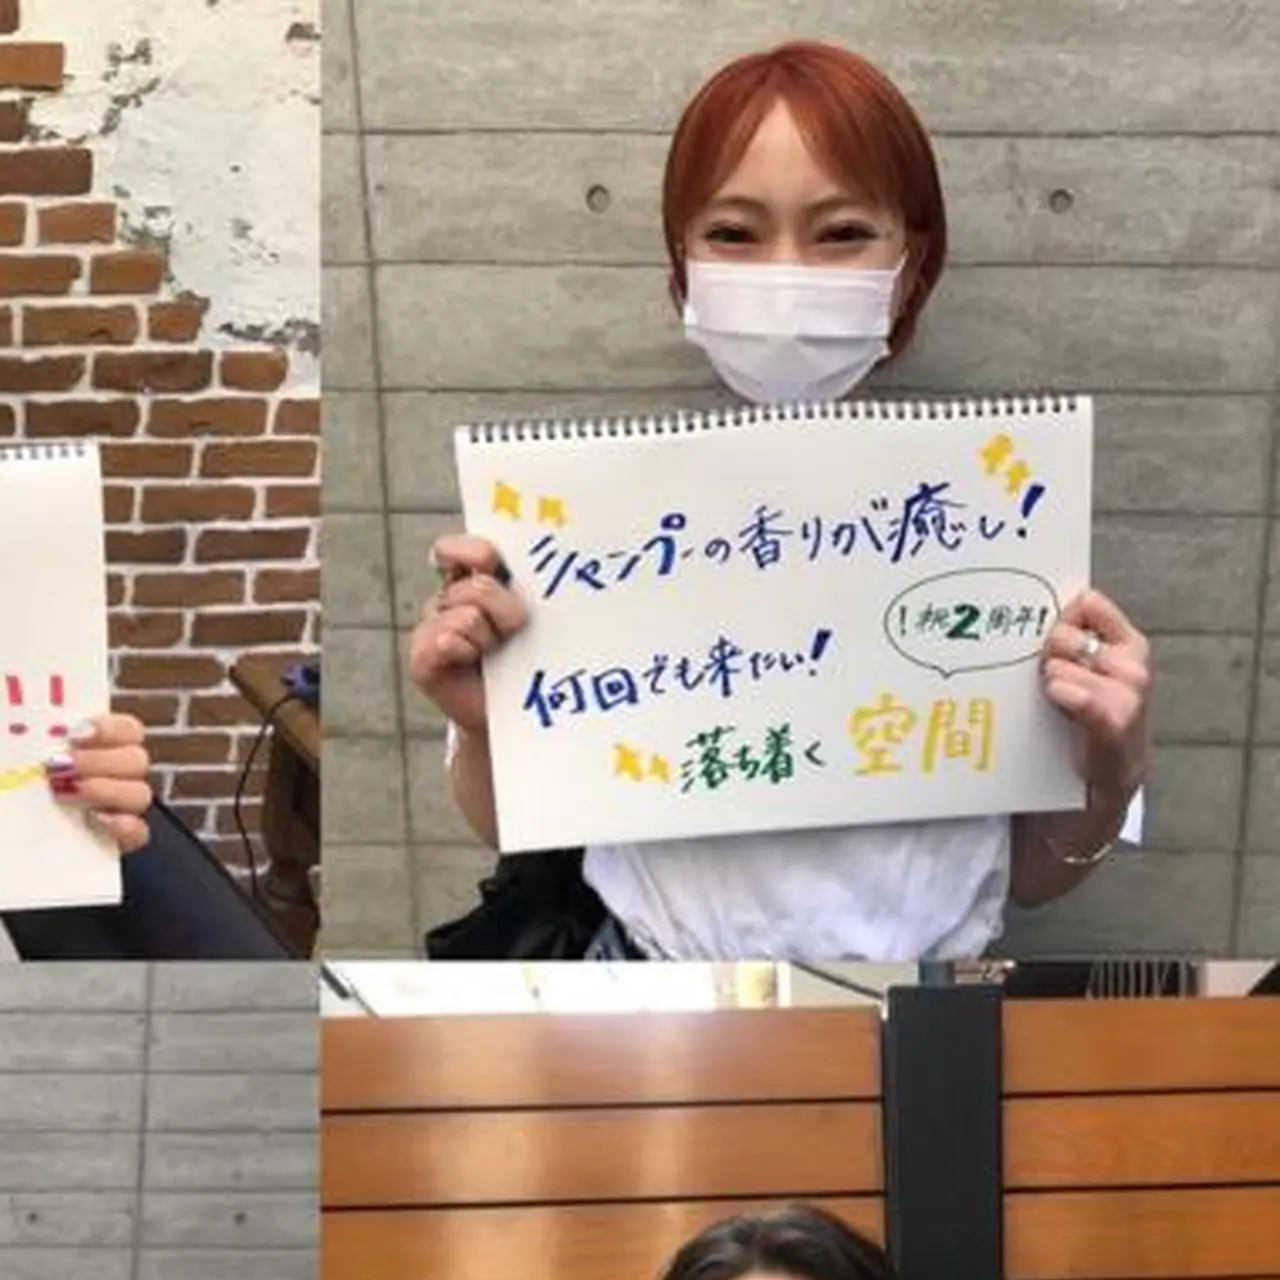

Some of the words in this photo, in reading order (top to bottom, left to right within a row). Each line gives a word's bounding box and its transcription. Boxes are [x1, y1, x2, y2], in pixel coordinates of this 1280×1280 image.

[523, 628, 833, 727] 何回でも来たい!
